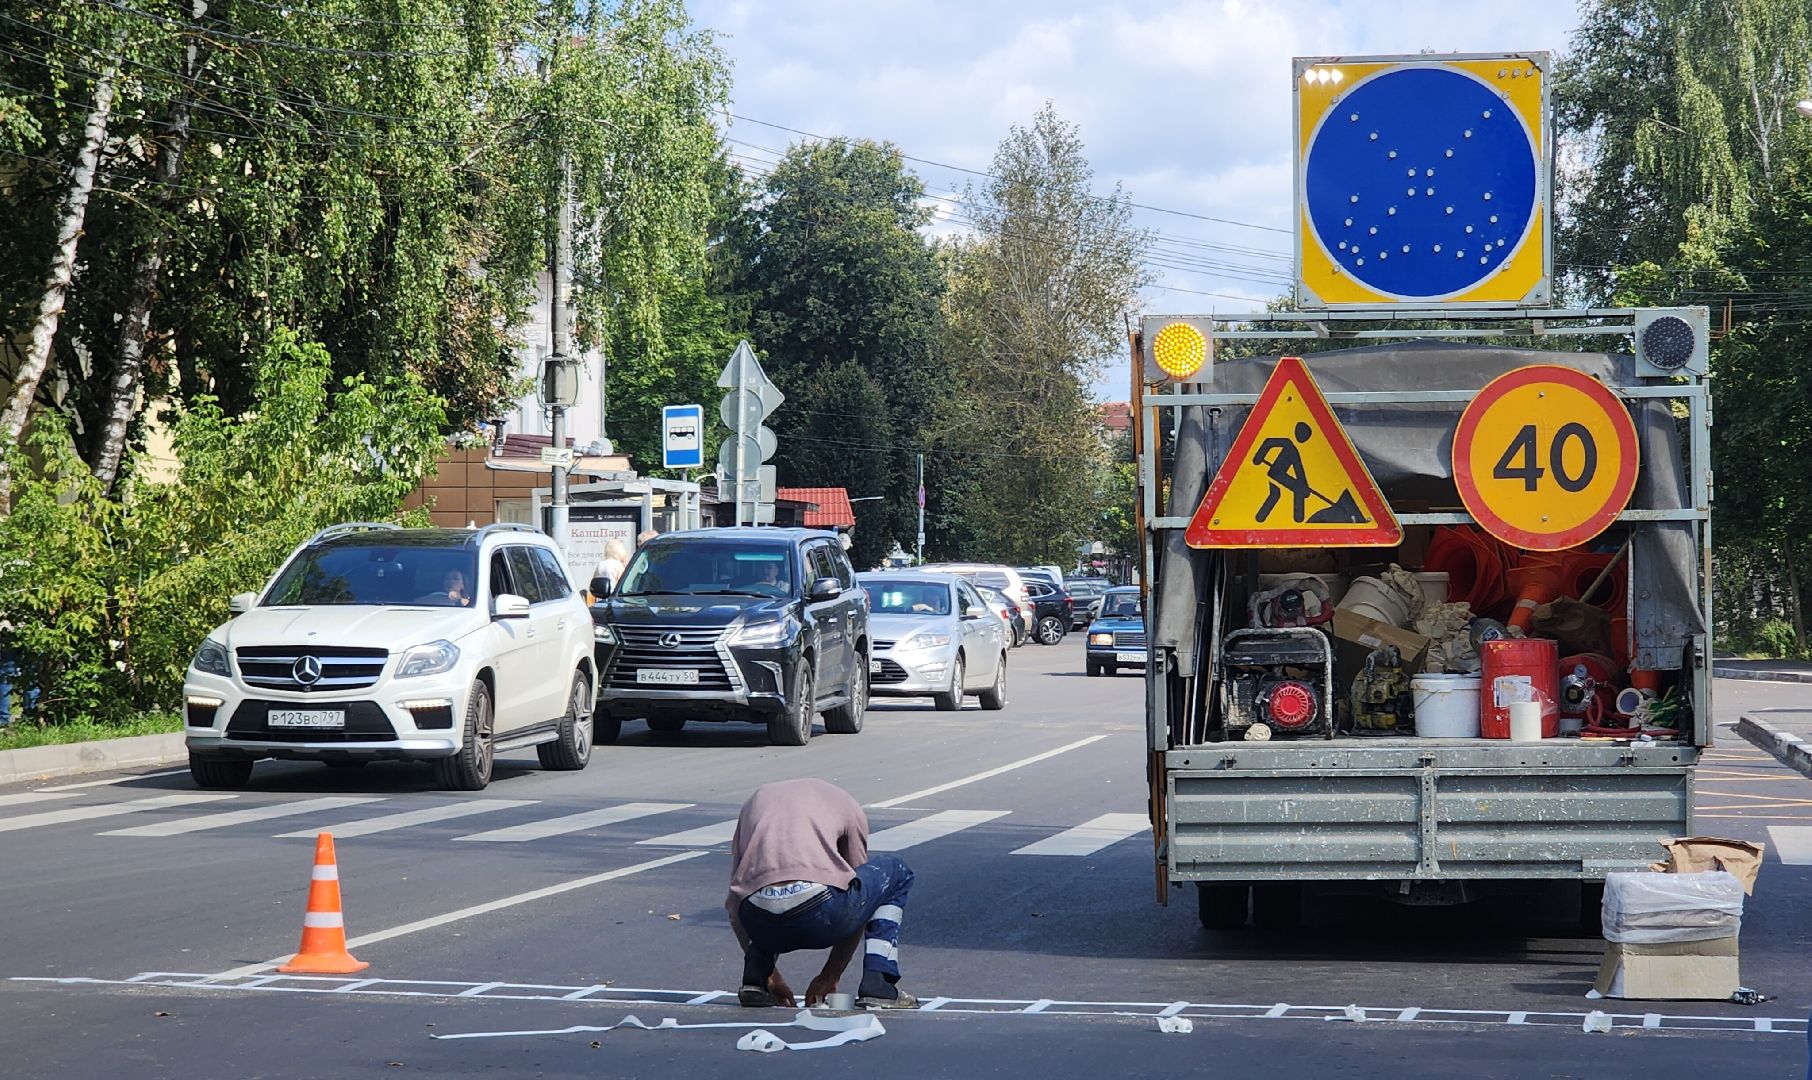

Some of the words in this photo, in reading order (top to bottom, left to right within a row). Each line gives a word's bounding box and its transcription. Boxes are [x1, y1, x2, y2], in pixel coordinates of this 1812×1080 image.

[1493, 422, 1597, 492] 40
[571, 528, 628, 540] КанцПарк
[641, 671, 681, 682] В444ТУ
[272, 712, 319, 725] Р123ВС
[322, 711, 341, 722] 797
